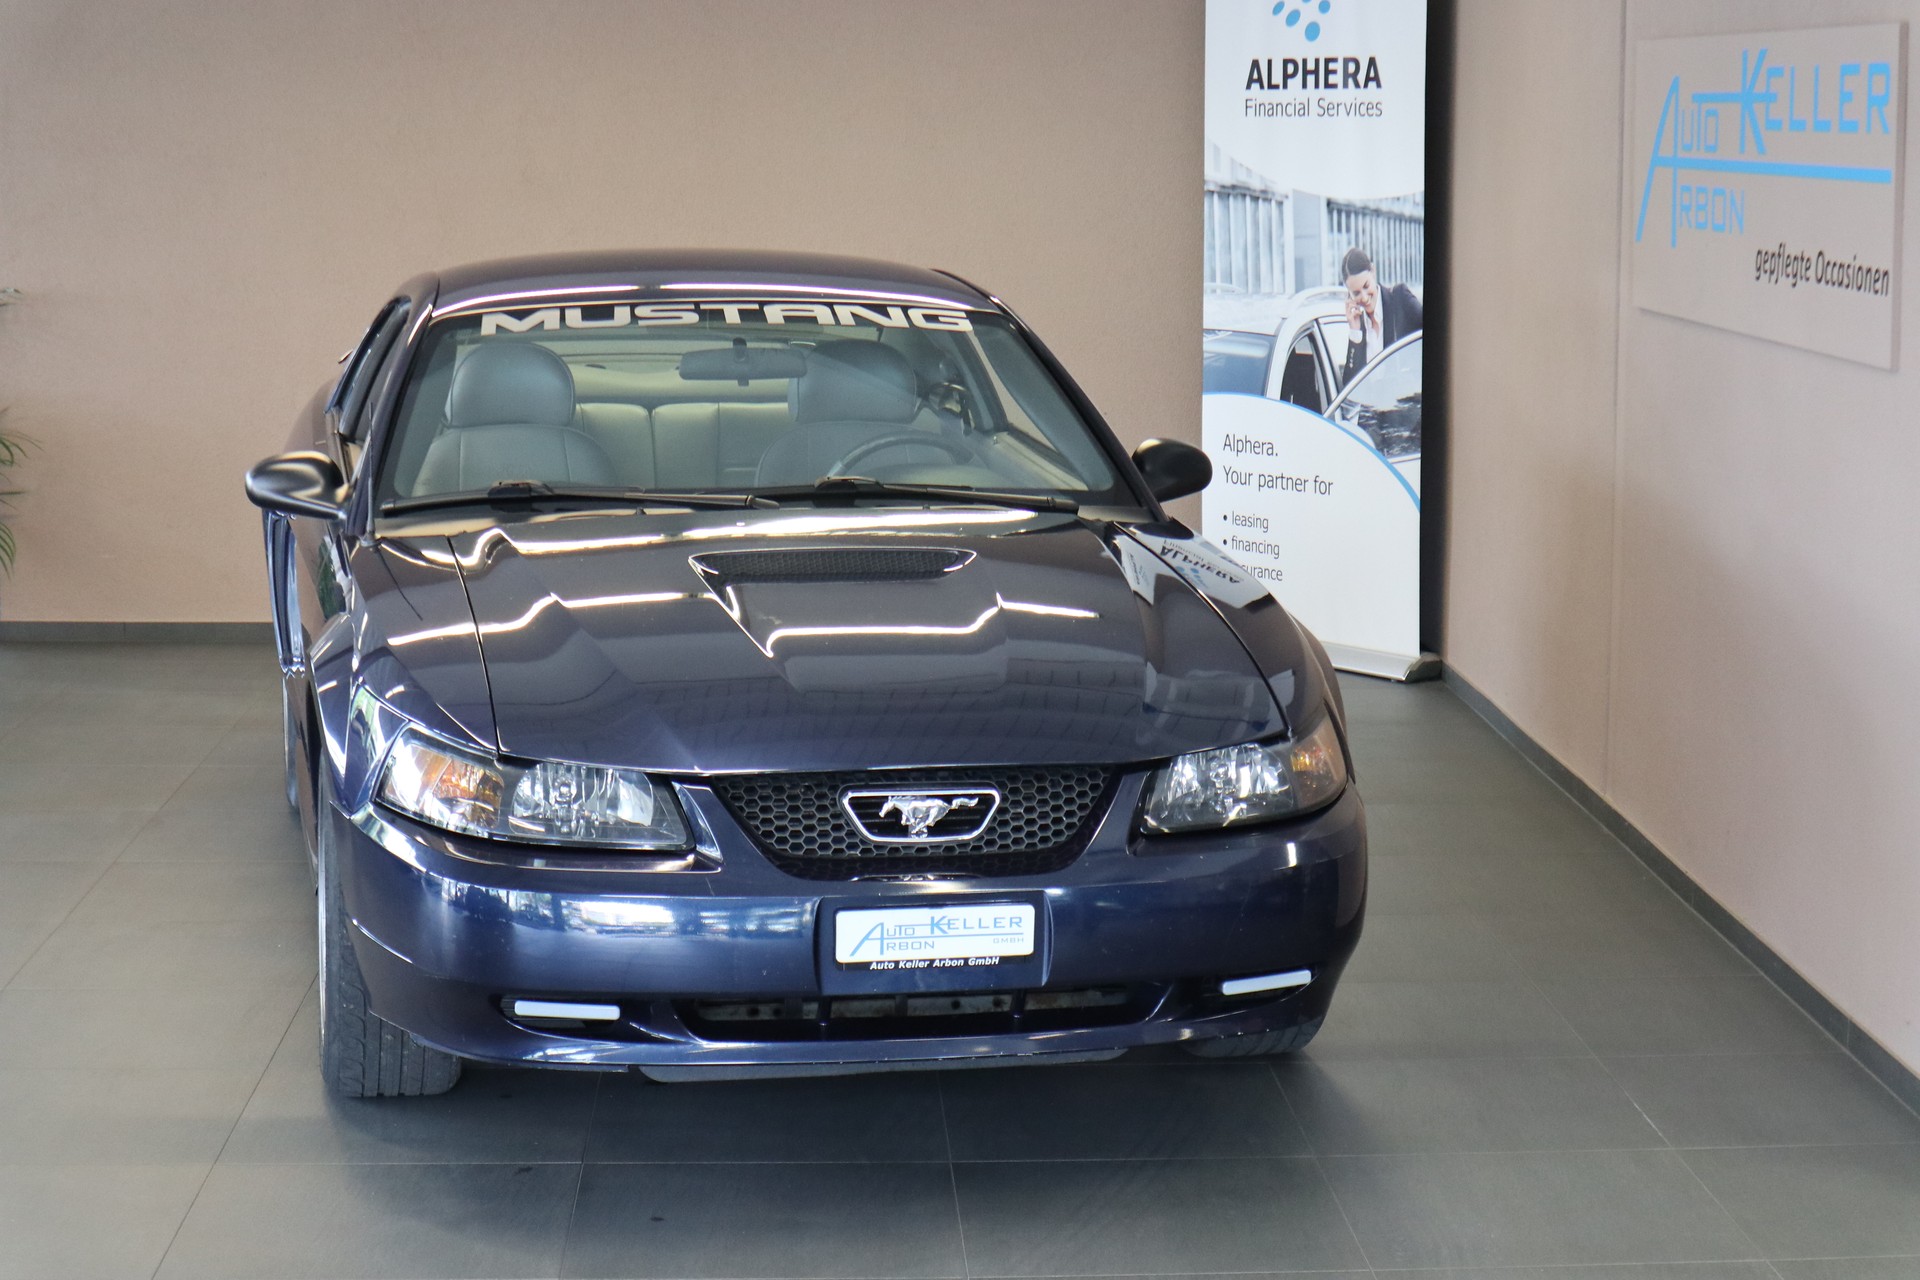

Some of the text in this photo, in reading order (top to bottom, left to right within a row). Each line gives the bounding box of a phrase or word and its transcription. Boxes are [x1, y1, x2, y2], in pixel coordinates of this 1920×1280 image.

[1245, 56, 1382, 90] ALPHERA
[1244, 97, 1383, 118] Financial Services
[1738, 48, 1892, 155] KELLER
[1755, 241, 1890, 298] gepflegte Occasionen
[480, 302, 974, 336] MUSTANG
[1222, 433, 1279, 457] Alphera.
[1222, 465, 1334, 495] Your partner for
[1231, 510, 1269, 533] leasing
[1231, 535, 1280, 559] financing
[930, 915, 1024, 935] KELLER
[869, 957, 1000, 970] Auto Keller Arbon GmbH
